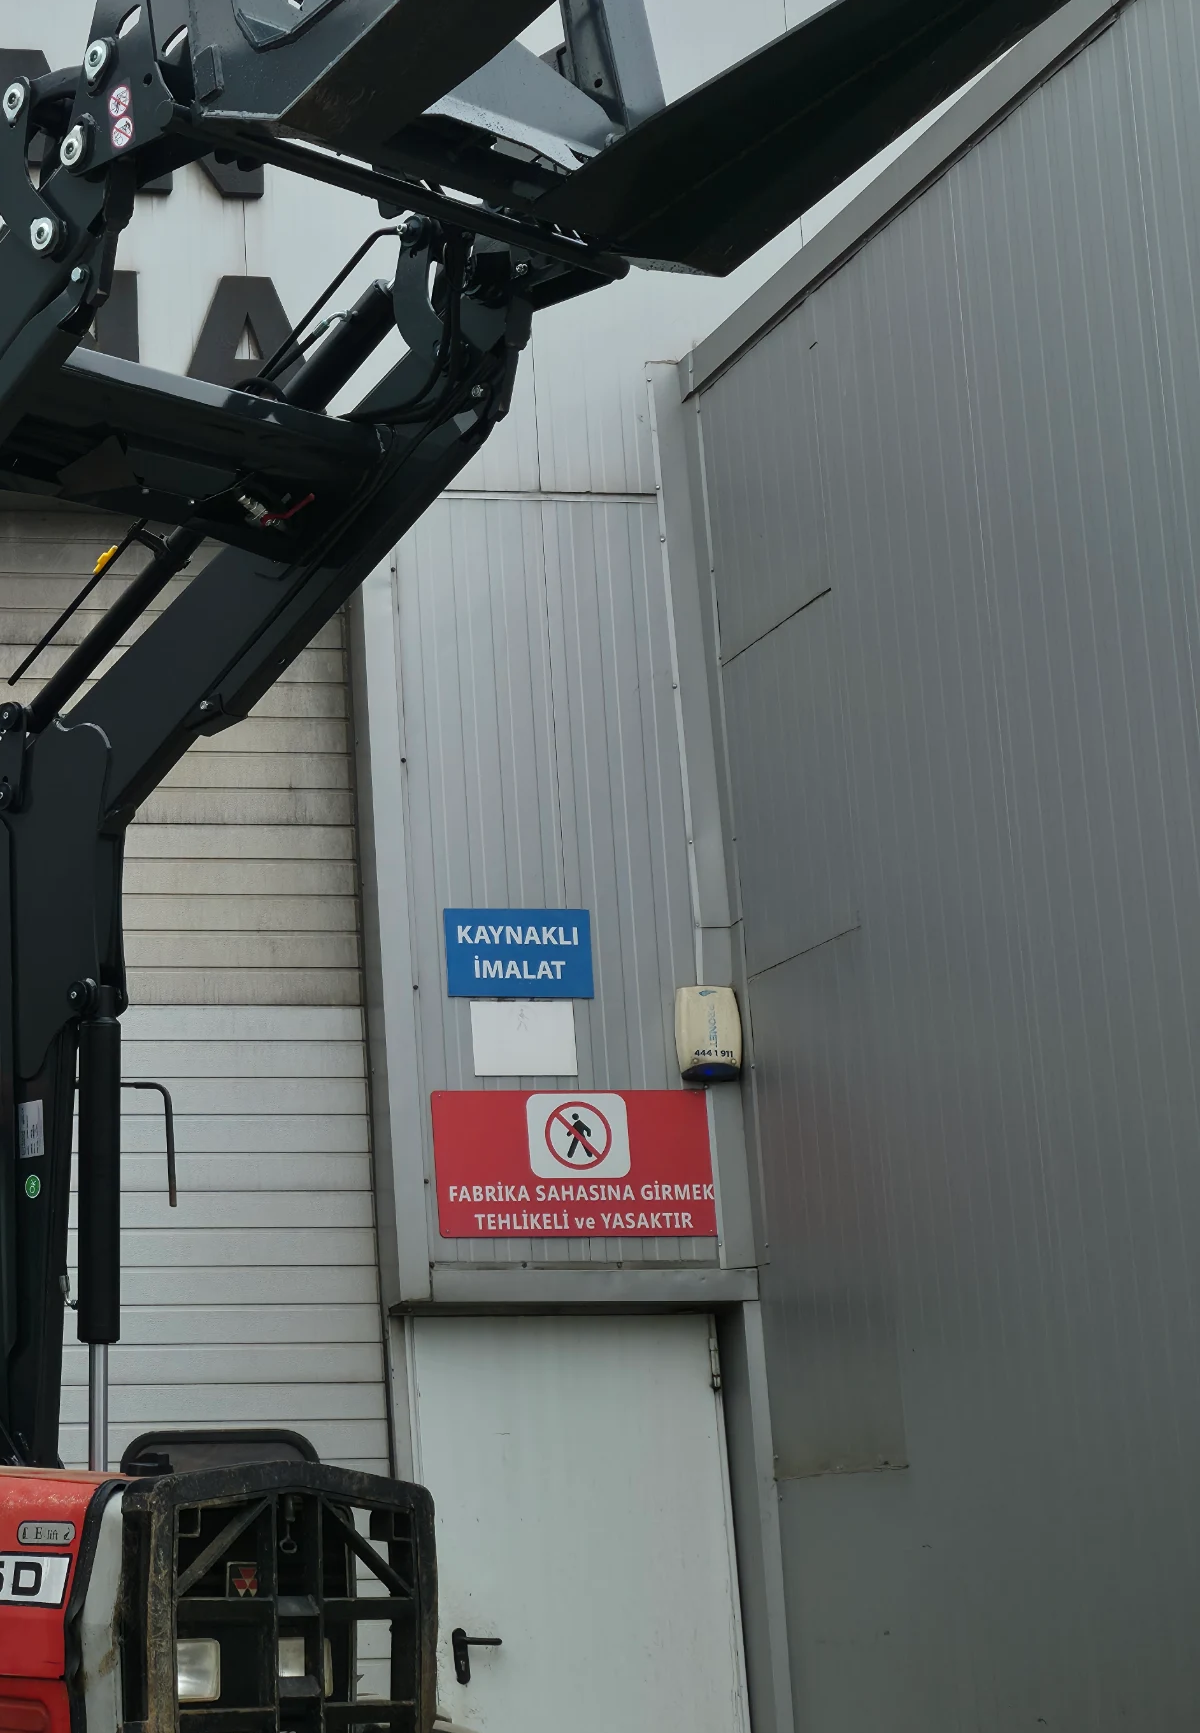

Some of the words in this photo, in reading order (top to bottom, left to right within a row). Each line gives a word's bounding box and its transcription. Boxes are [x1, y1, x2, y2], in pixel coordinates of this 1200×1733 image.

[457, 925, 579, 946] KAYNAKLI
[474, 955, 566, 980] İMALAT
[694, 1049, 713, 1057] 444
[720, 1050, 734, 1058] 911
[29, 1179, 37, 1194] OK
[449, 1181, 530, 1202] FABRİKA
[535, 1184, 635, 1201] SAHASINA
[640, 1180, 715, 1201] GİRMEK
[474, 1210, 569, 1231] TEHLİKELİ
[574, 1217, 596, 1230] ve
[600, 1212, 694, 1229] YASAKTIR
